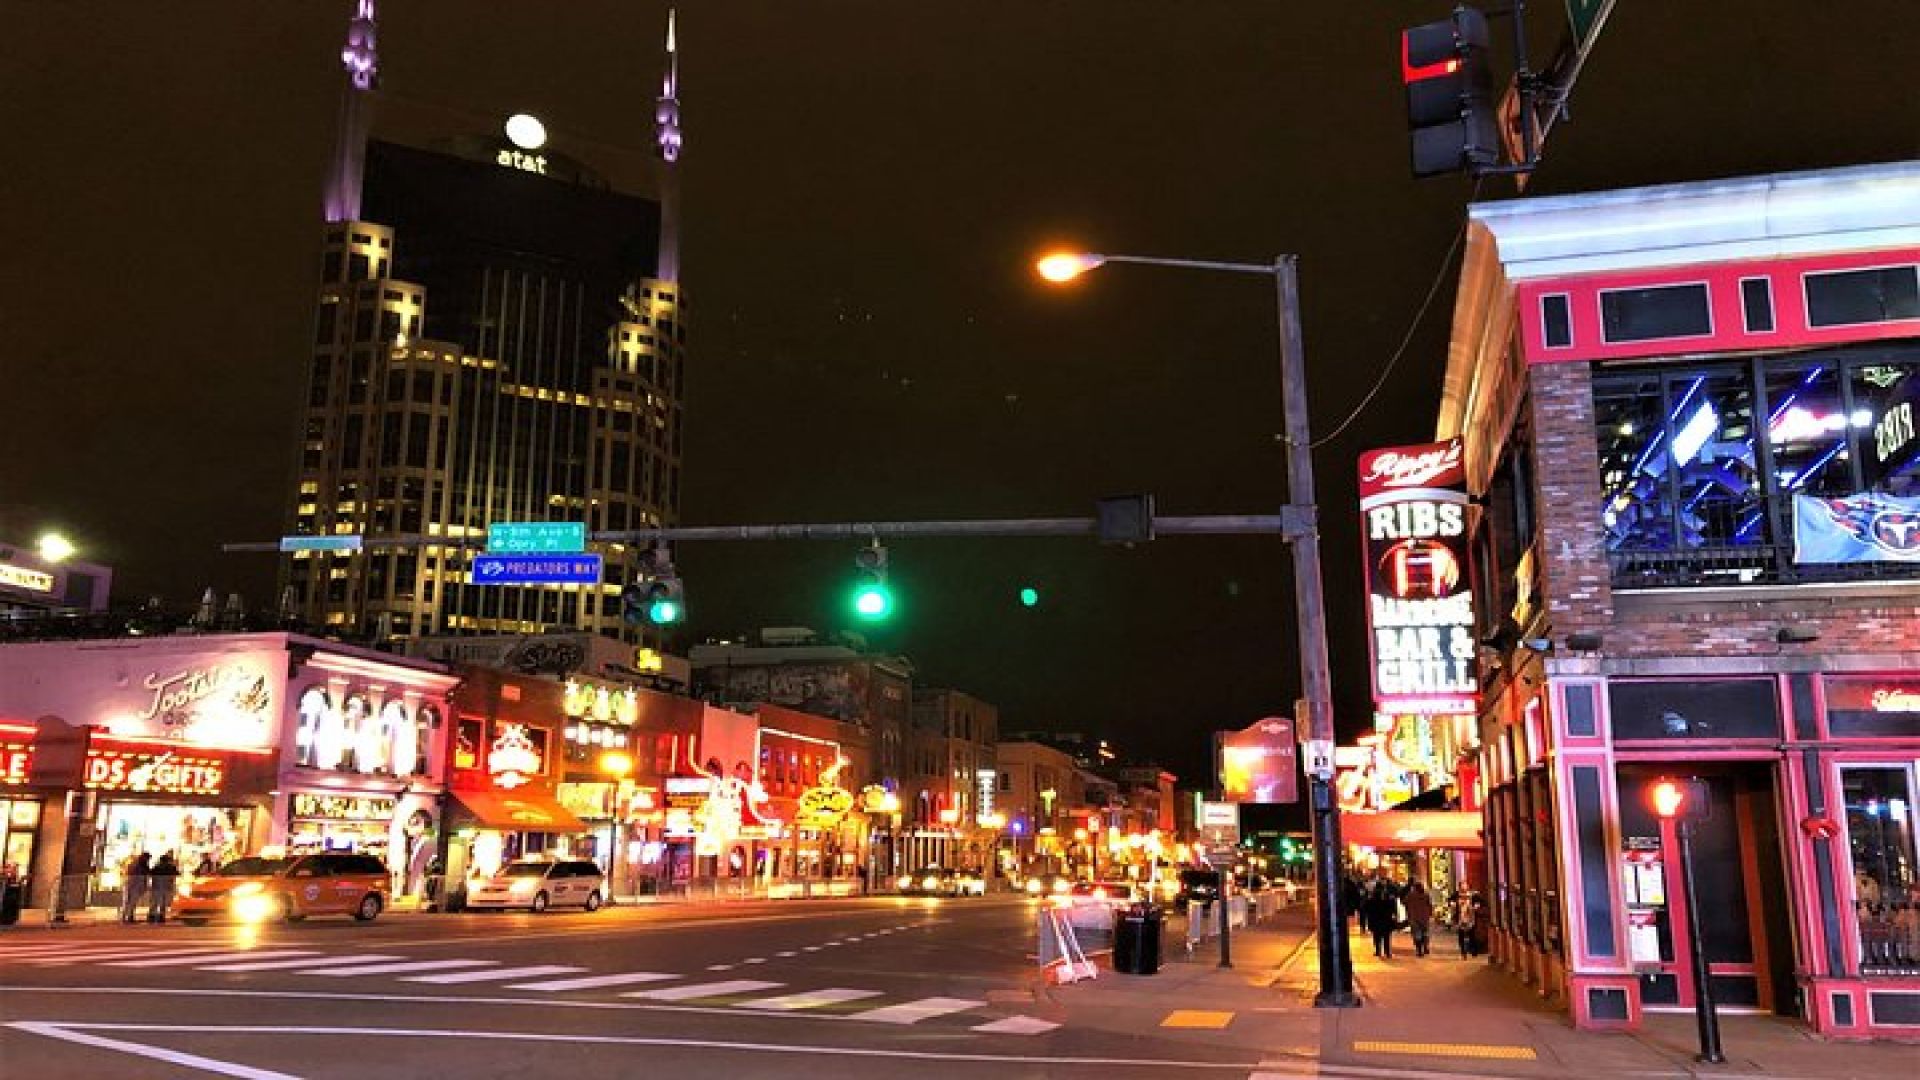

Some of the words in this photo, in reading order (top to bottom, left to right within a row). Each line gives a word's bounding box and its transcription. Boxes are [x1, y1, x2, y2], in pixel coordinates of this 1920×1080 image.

[1370, 502, 1464, 540] RIBS
[506, 562, 569, 575] PREDATORS
[1378, 627, 1442, 660] BAR
[1449, 627, 1475, 660] &
[1379, 660, 1477, 693] GRILL
[154, 763, 223, 787] GIFTS
